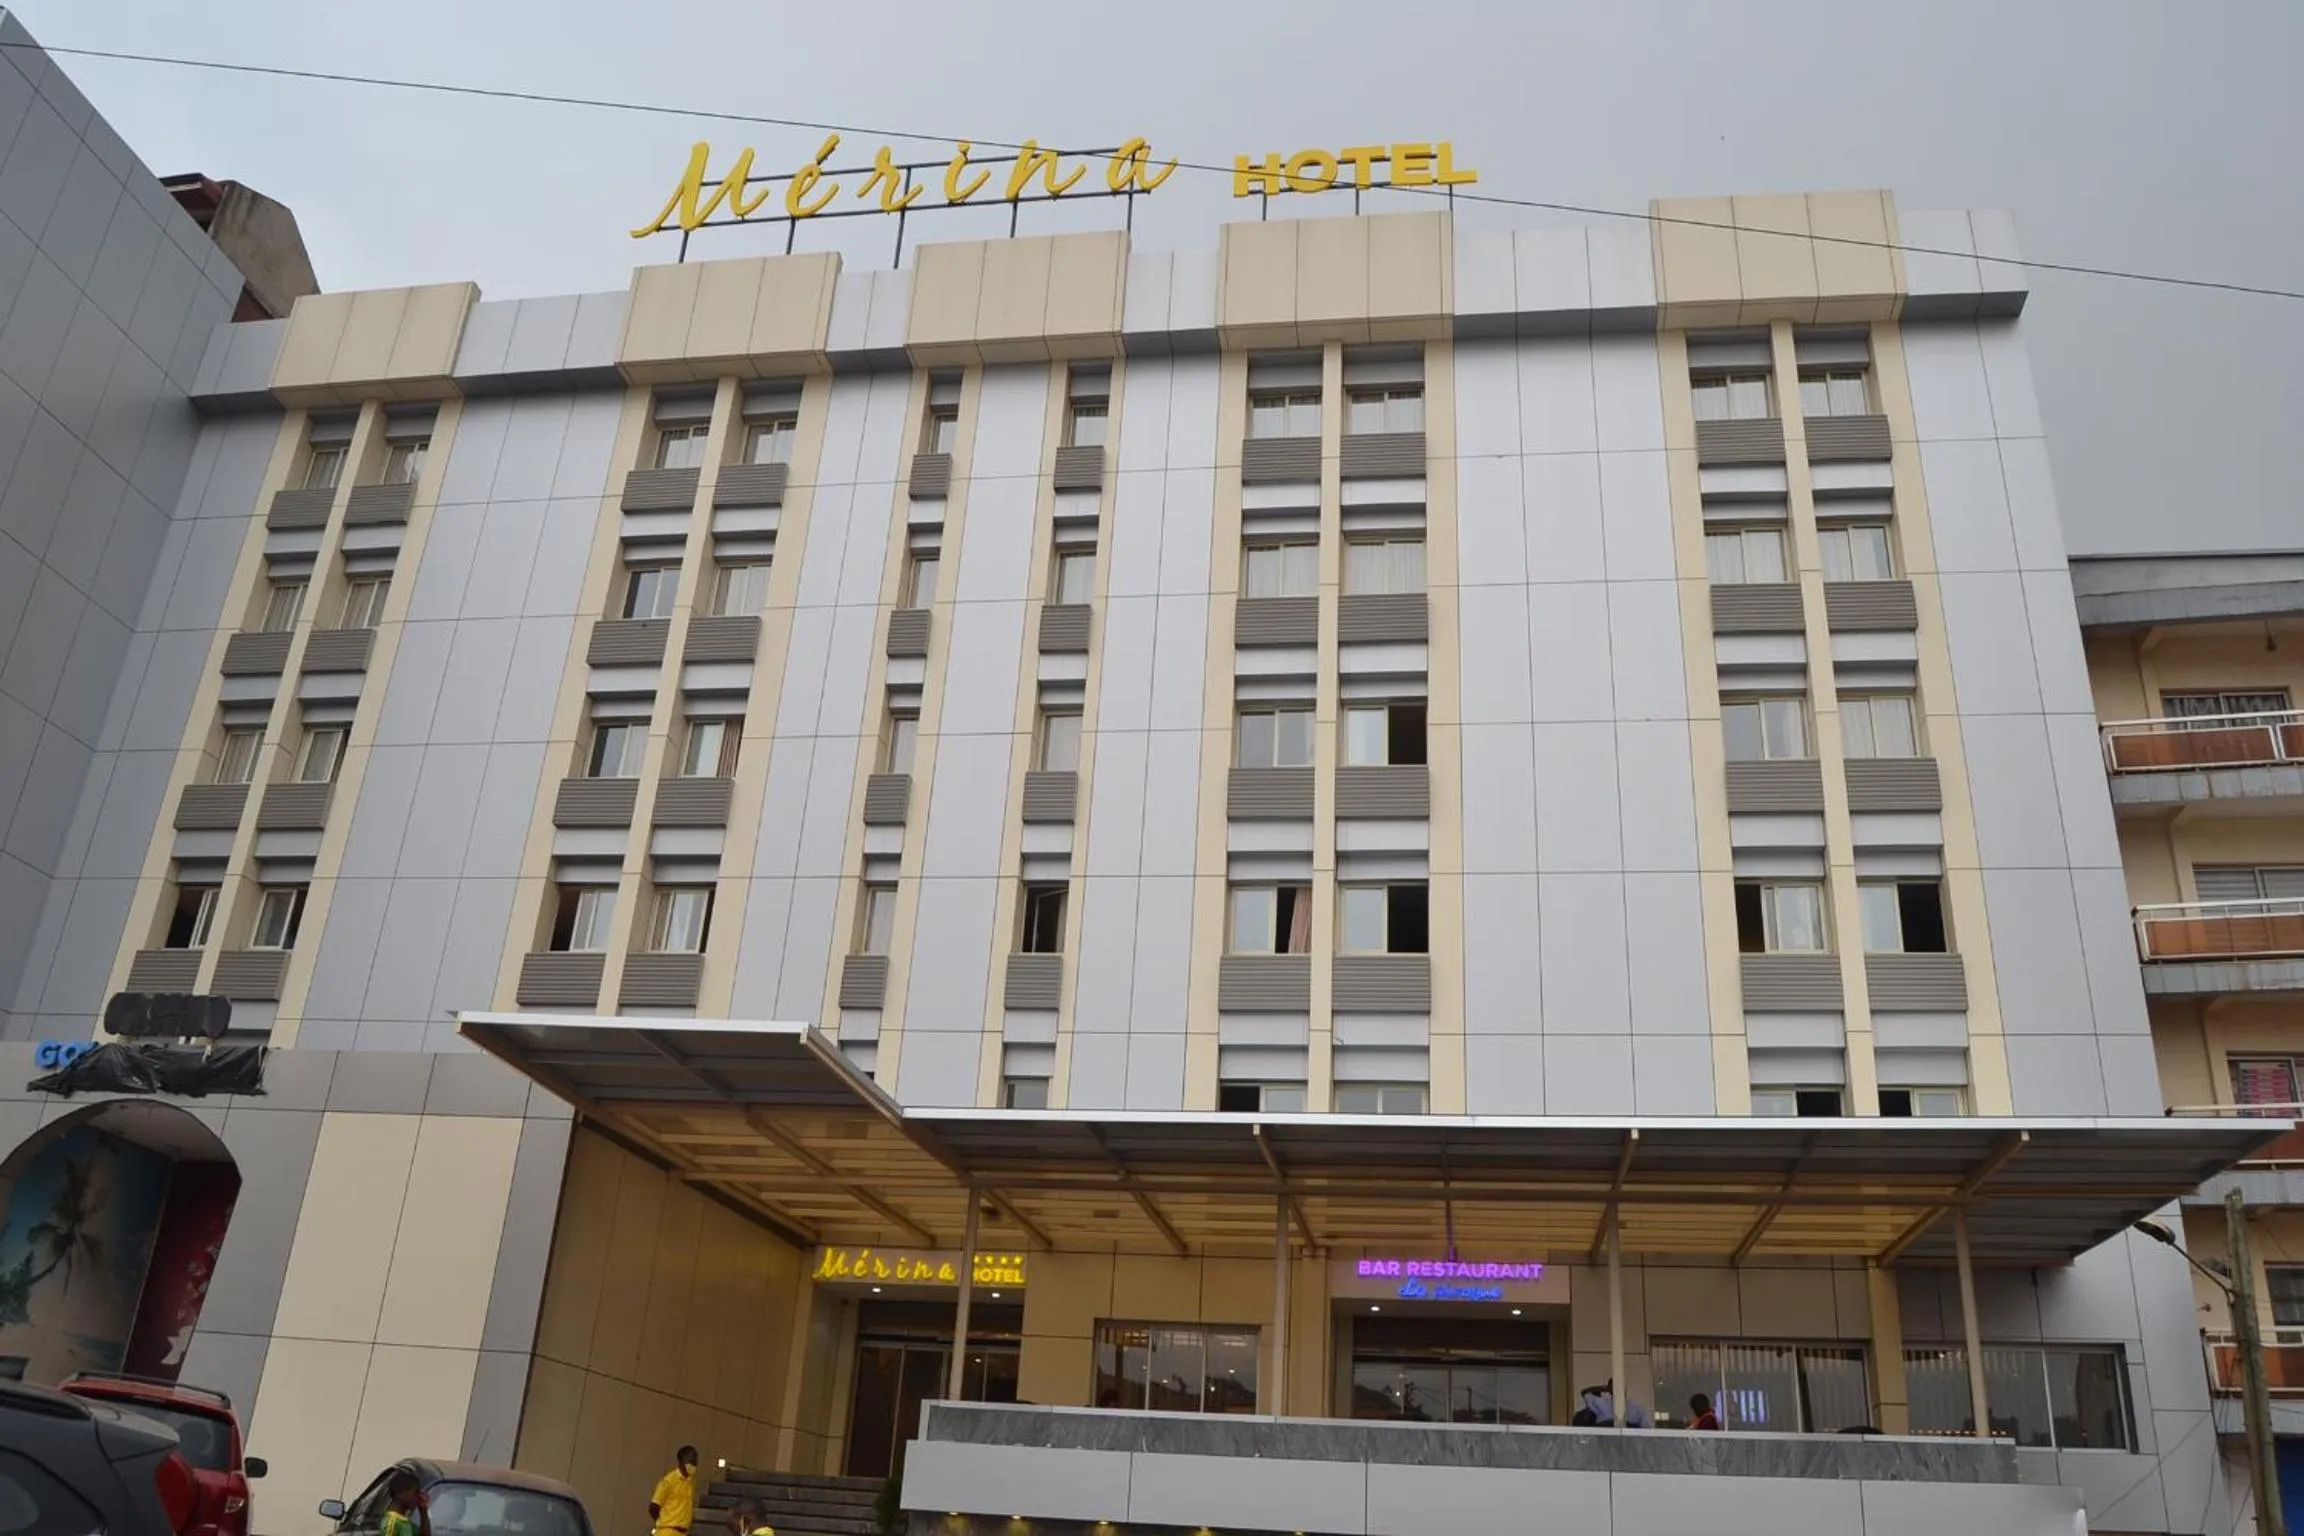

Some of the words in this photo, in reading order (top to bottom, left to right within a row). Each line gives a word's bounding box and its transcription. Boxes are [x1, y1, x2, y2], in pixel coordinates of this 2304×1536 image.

[632, 133, 1178, 237] Mérina
[1233, 141, 1479, 197] HOTEL
[812, 1247, 956, 1281] Mérina
[1358, 1260, 1400, 1276] BAR
[1406, 1261, 1544, 1280] RESTAURANT
